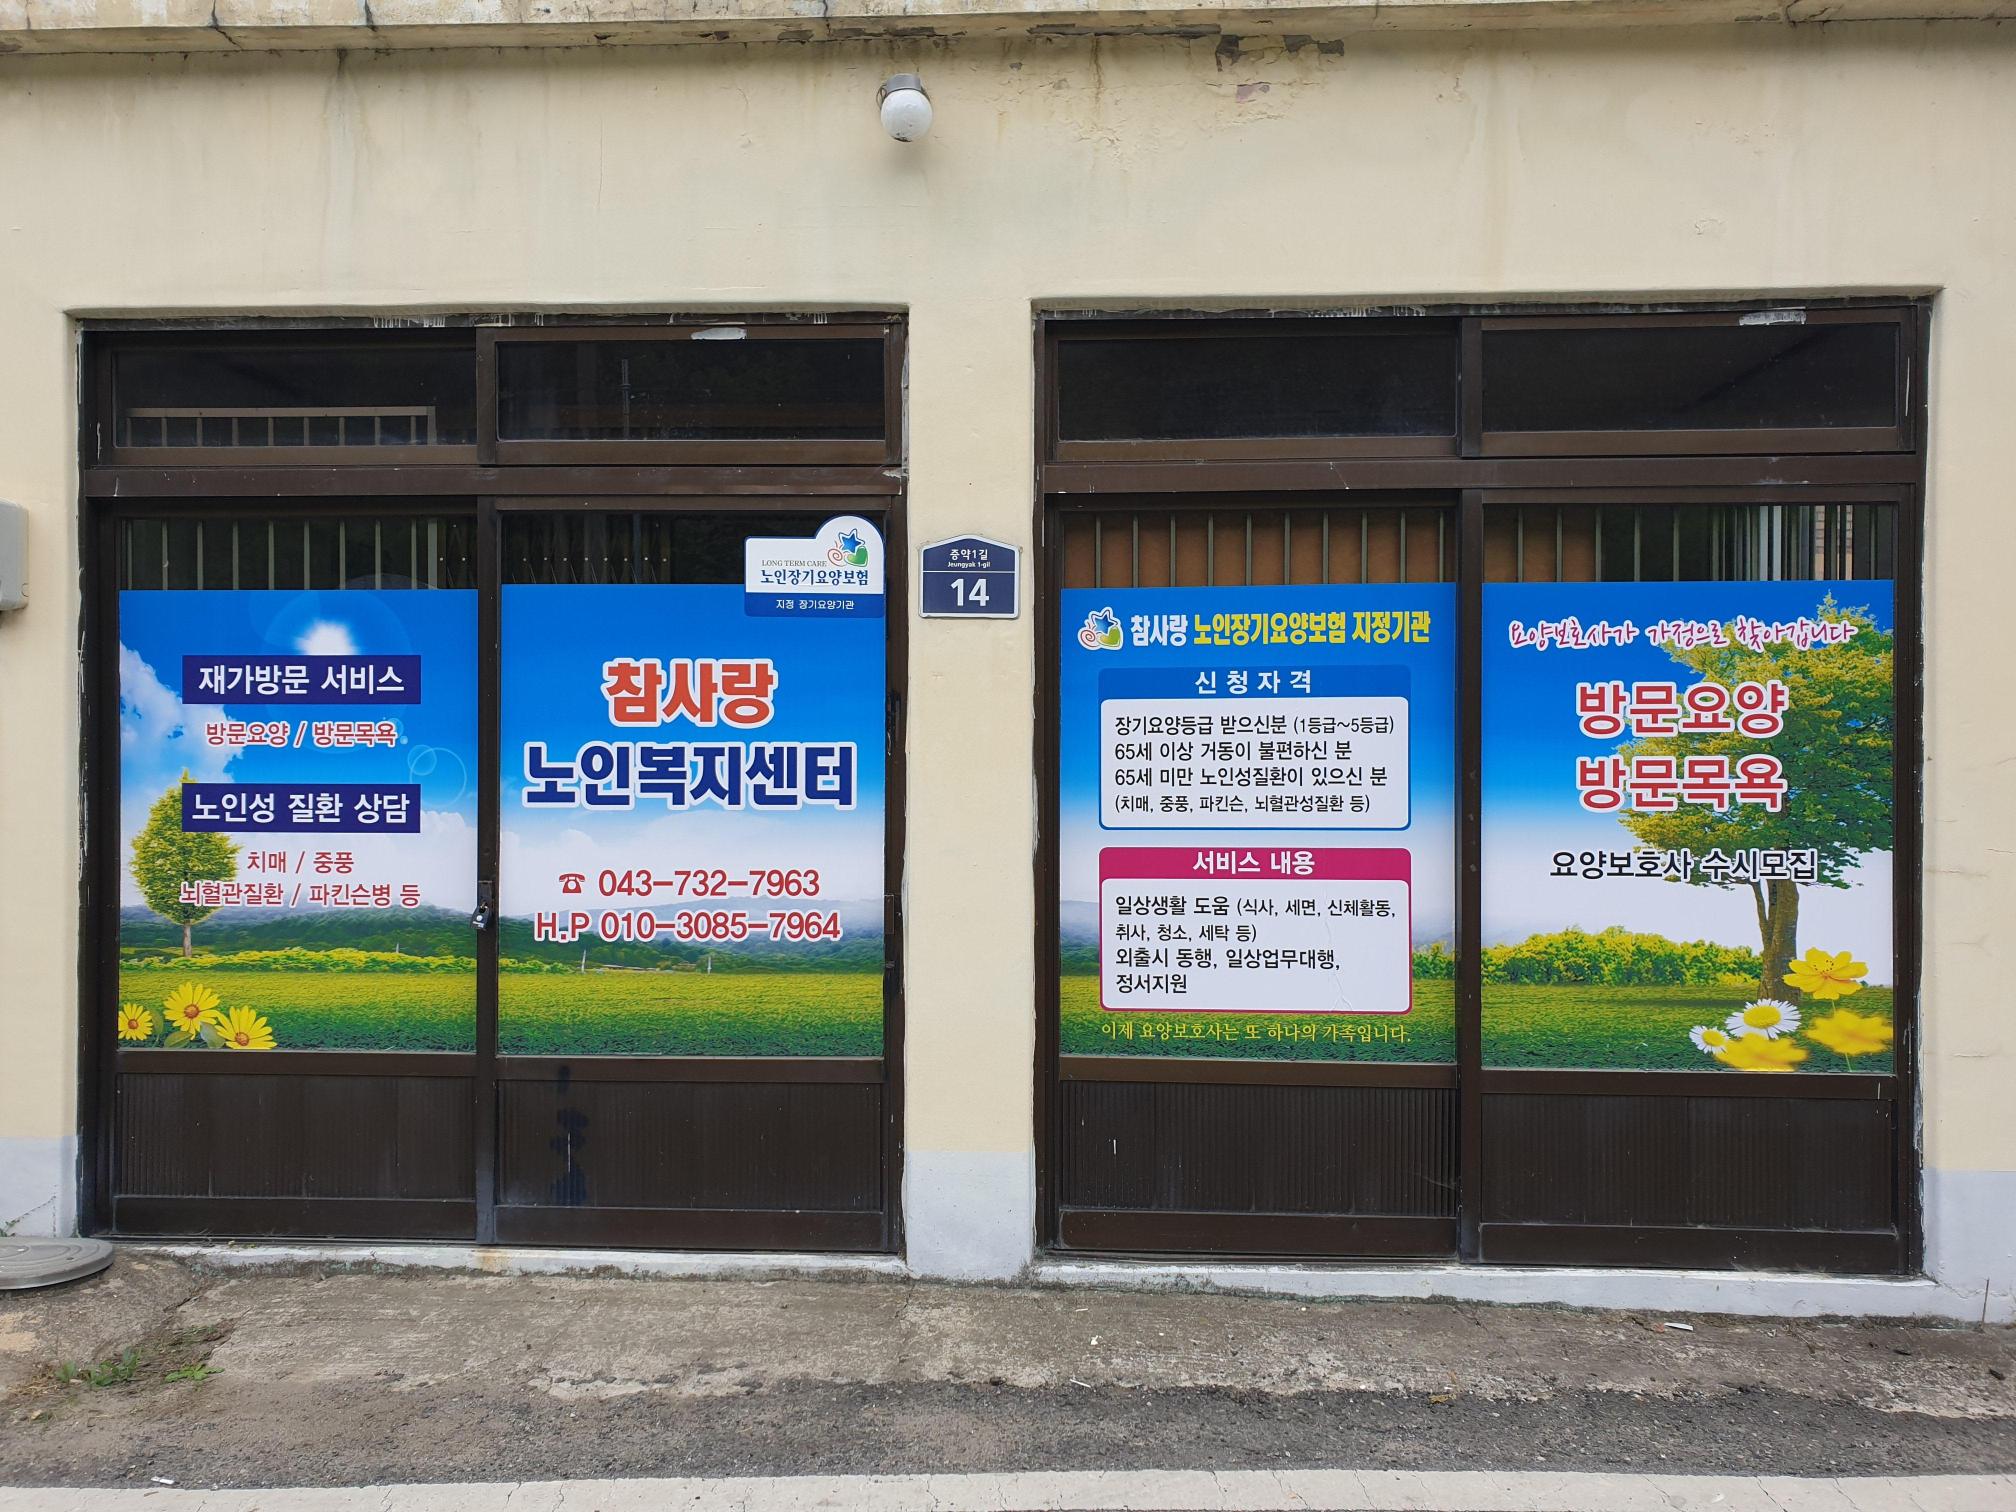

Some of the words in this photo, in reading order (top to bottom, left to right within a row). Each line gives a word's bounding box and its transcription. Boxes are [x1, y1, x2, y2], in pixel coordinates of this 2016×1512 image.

[950, 549, 987, 560] 증약1길
[761, 569, 869, 586] 노인장기요양보험
[776, 599, 794, 609] 지정
[799, 600, 854, 610] 장기요양기관
[950, 578, 990, 607] 14
[1130, 614, 1188, 647] 참사랑
[1194, 612, 1345, 645] 노인장기요양보험
[1352, 610, 1431, 643] 지정기관
[1510, 618, 1637, 649] 요양보호사가
[1647, 622, 1727, 648] 가정으로
[1737, 616, 1857, 650] 찾아갑니다
[199, 665, 309, 694] 재가방문
[321, 665, 404, 694] 서비스
[604, 661, 776, 726] 참사랑
[1578, 682, 1786, 736] 방문요양
[206, 722, 288, 745] 방문요양
[296, 723, 306, 746] /
[314, 722, 396, 746] 방문목욕
[1115, 716, 1213, 735] 장기요양등급
[1220, 715, 1287, 733] 받으신분
[1115, 741, 1152, 761] 65세
[1160, 742, 1193, 761] 이상
[1201, 741, 1251, 761] 거동이
[1258, 741, 1327, 760] 불편하신
[1334, 741, 1352, 759] 분
[525, 744, 854, 807] 노인복지센터
[1115, 767, 1152, 787] 65세
[1160, 768, 1193, 786] 미만
[1200, 766, 1304, 786] 노인성질환이
[1311, 767, 1362, 786] 있으신
[1370, 766, 1388, 786] 분
[1578, 757, 1785, 810] 방문목욕
[192, 793, 275, 822] 노인성
[288, 793, 342, 822] 질환
[354, 794, 409, 823] 상담
[1115, 795, 1154, 814] (치매,
[1159, 796, 1193, 813] 중풍,
[1200, 795, 1248, 813] 파킨슨,
[1254, 795, 1343, 813] 뇌혈관성질환
[1350, 795, 1370, 813] 등)
[248, 852, 287, 873] 치매
[296, 852, 305, 874] /
[314, 852, 354, 873] 중풍
[1193, 851, 1261, 874] 서비스
[1270, 851, 1315, 875] 내용
[1550, 850, 1692, 880] 요양보호사
[1702, 850, 1816, 880] 수시모집
[180, 882, 284, 906] 뇌혈관질환
[291, 884, 301, 906] /
[309, 884, 391, 906] 파킨슨병
[399, 884, 420, 906] 등
[599, 869, 820, 897] 043-732-7963
[1115, 896, 1186, 916] 일상생활
[1193, 896, 1229, 915] 도움
[1236, 898, 1278, 917] (식사,
[1285, 899, 1321, 917] 세면,
[1327, 899, 1396, 917] 신체활동,
[537, 911, 590, 941] H.P
[601, 911, 841, 941] 010-3085-7964
[1115, 924, 1151, 942] 취사,
[1157, 924, 1192, 942] 청소,
[1199, 924, 1229, 942] 세탁
[1235, 924, 1258, 942] 등)
[1115, 949, 1169, 969] 외출시
[1176, 948, 1217, 969] 동행,
[1226, 949, 1340, 970] 일상업무대행,
[1115, 974, 1187, 994] 정서지원
[1101, 1023, 1133, 1040] 이제
[1139, 1023, 1240, 1041] 요양보호사는
[1245, 1024, 1261, 1040] 또
[1267, 1024, 1317, 1041] 하나의
[1322, 1024, 1412, 1043] 가족입니다.
